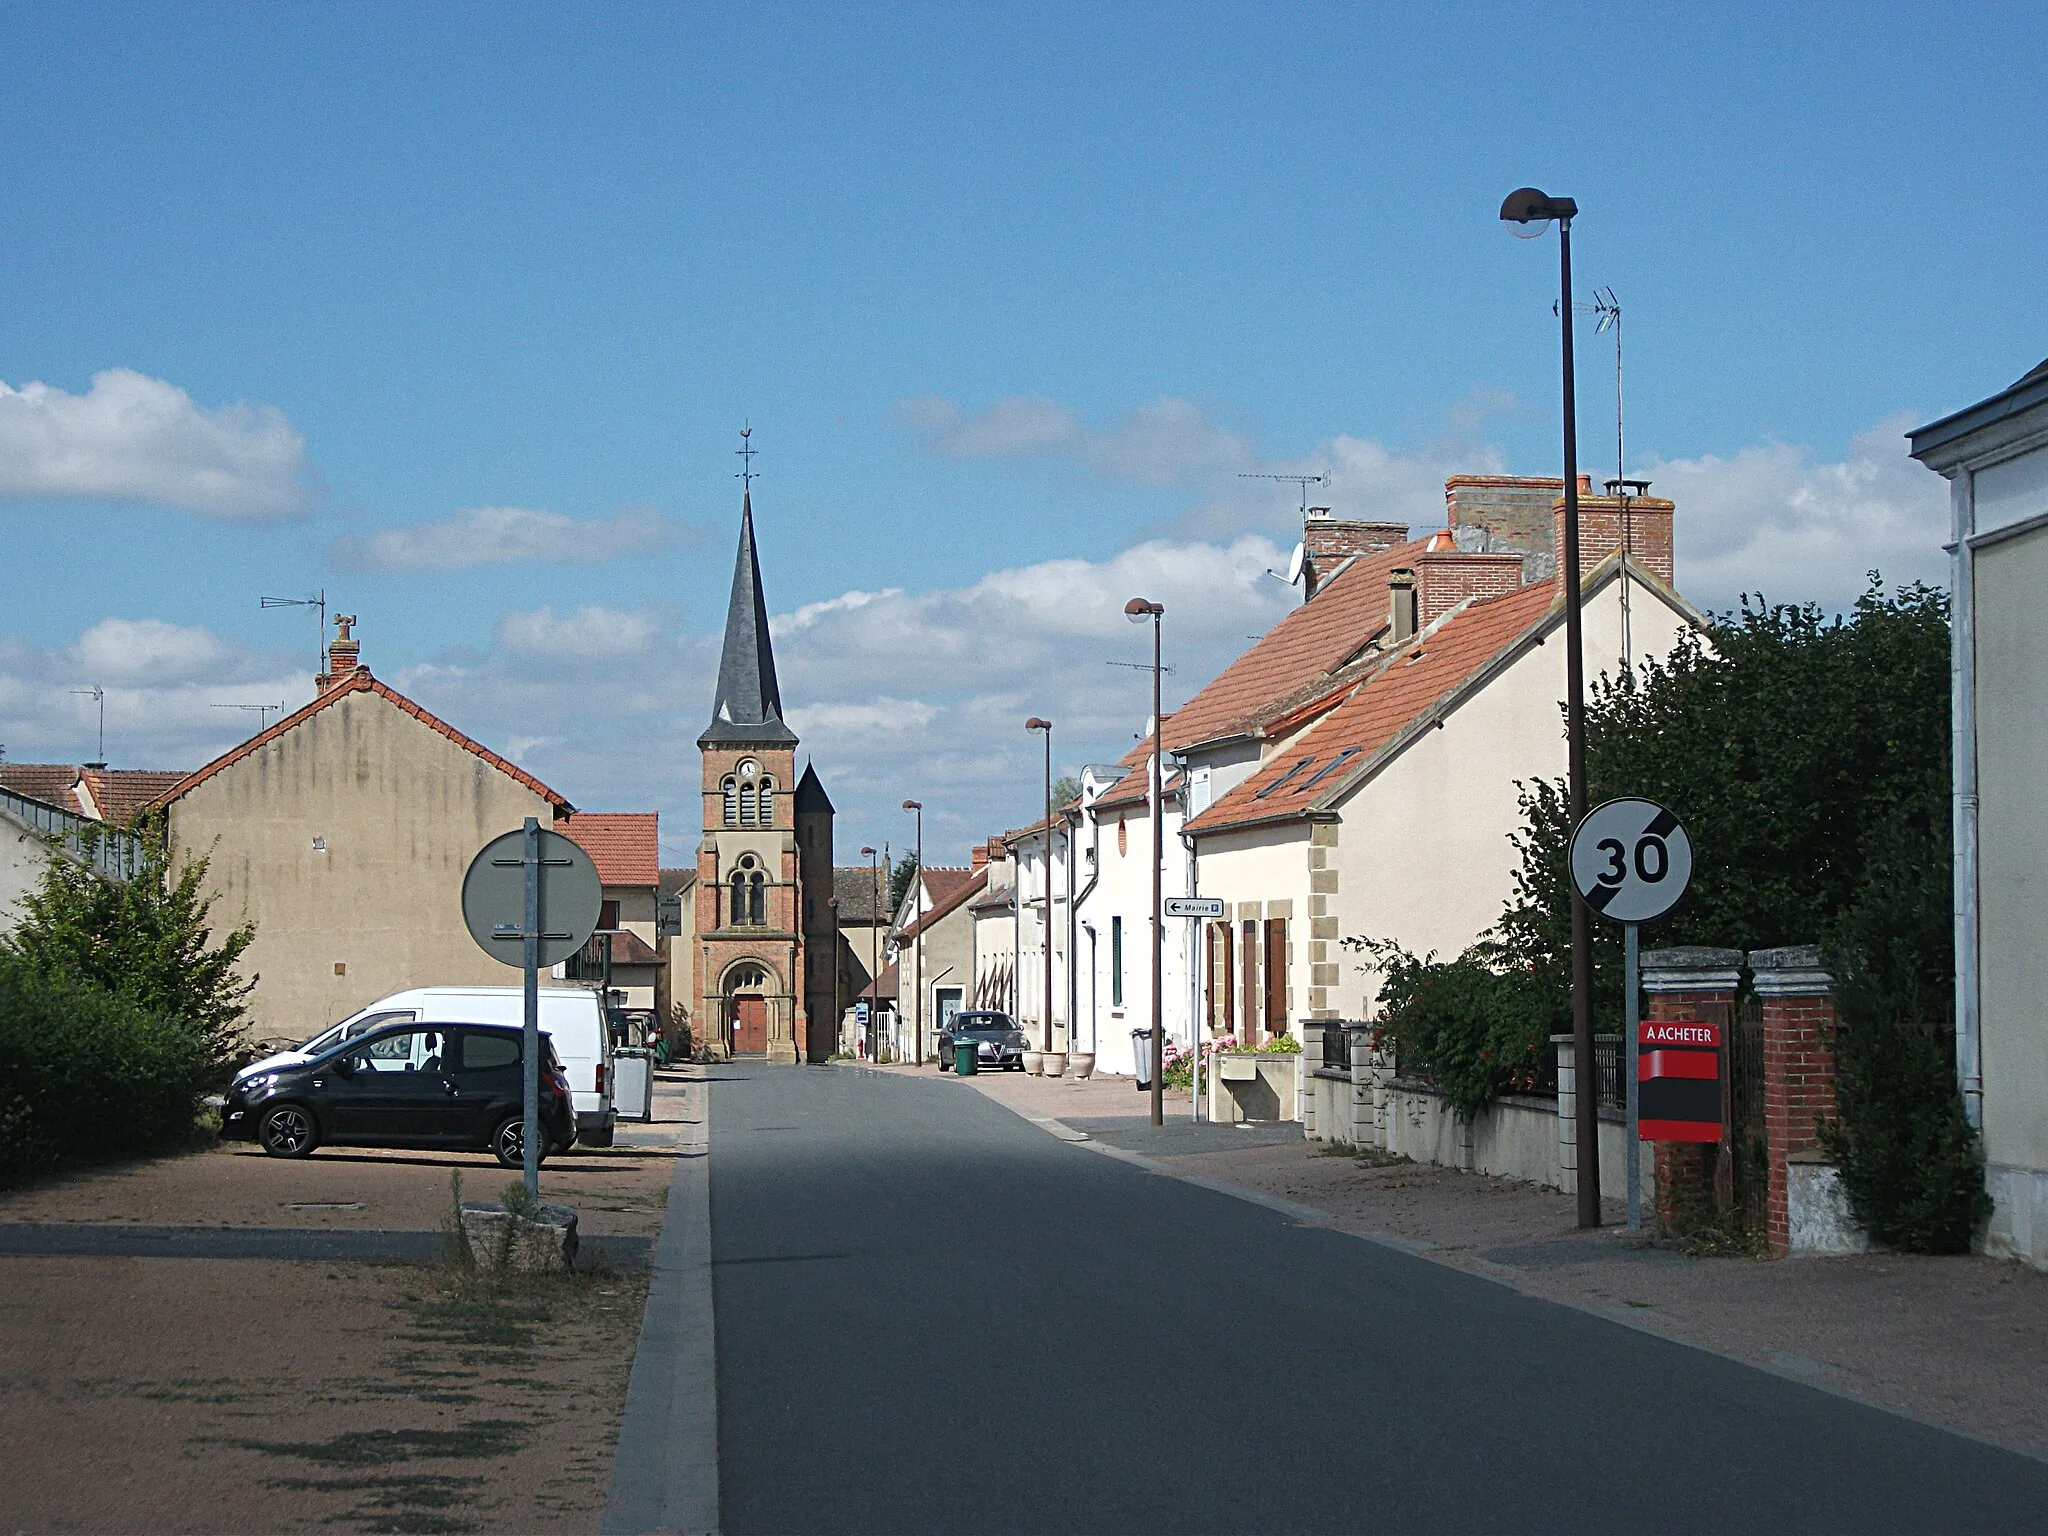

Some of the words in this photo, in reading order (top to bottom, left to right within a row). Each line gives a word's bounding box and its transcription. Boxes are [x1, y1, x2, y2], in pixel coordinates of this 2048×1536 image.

[1596, 835, 1669, 885] 30
[1647, 1026, 1655, 1040] A
[1657, 1027, 1712, 1042] ACHETER
